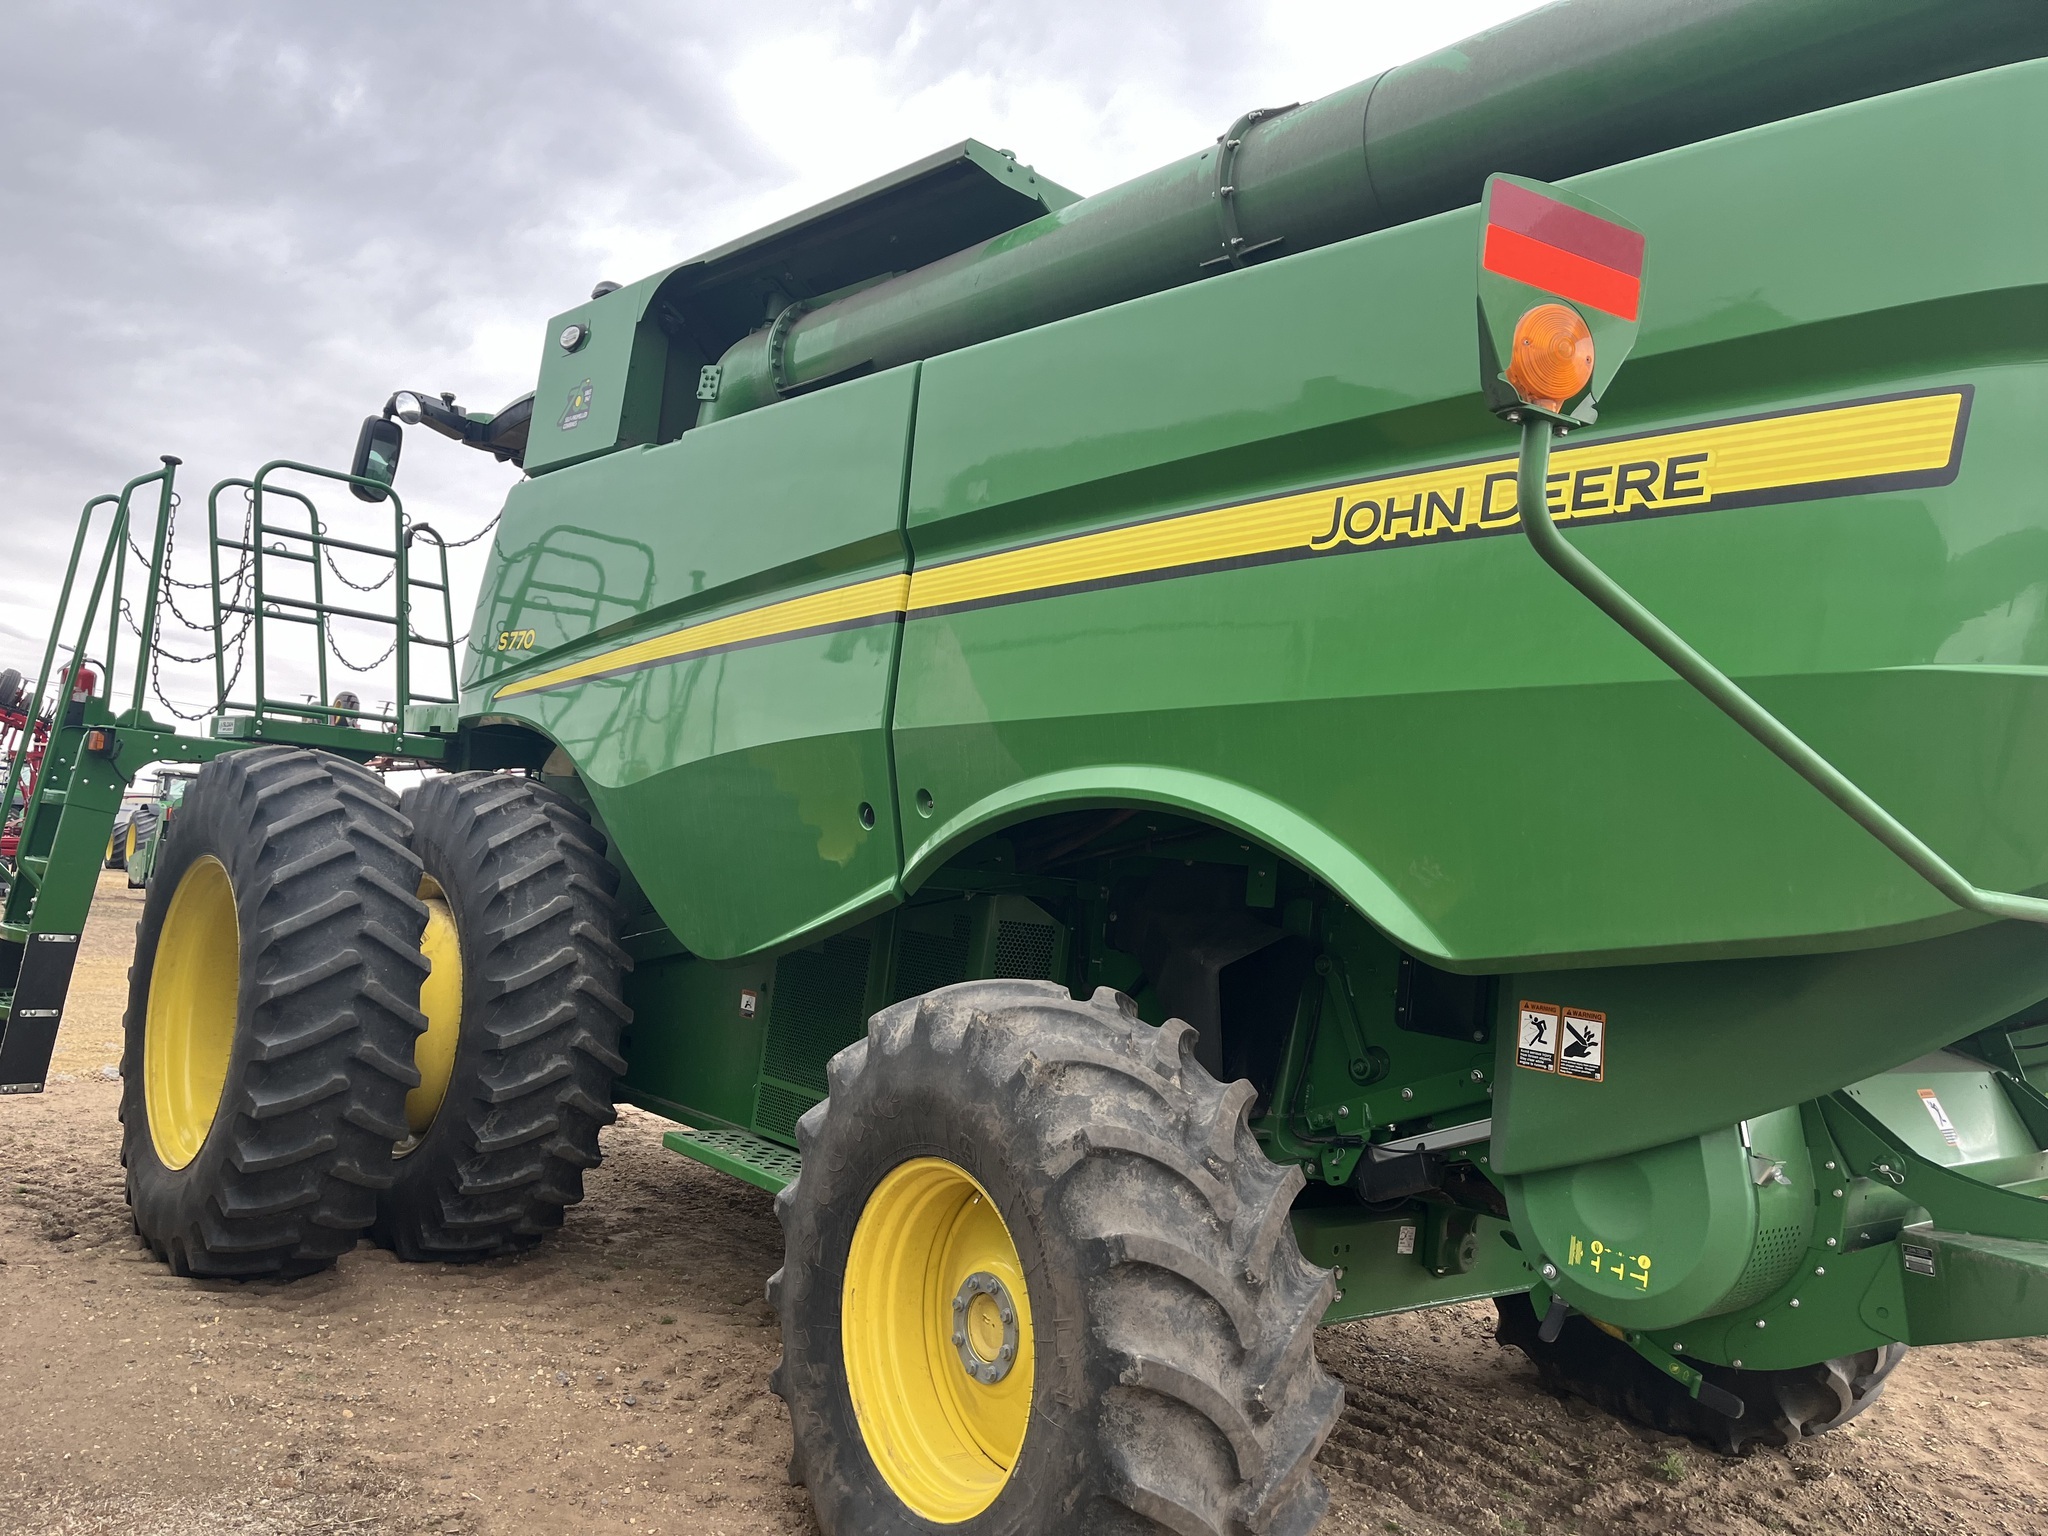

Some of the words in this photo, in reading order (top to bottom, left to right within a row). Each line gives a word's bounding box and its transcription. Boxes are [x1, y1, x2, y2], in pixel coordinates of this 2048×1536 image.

[1311, 486, 1466, 544] JOHN
[1480, 452, 1709, 523] DEERE
[497, 629, 536, 652] S770
[1531, 1003, 1557, 1013] WARNING
[1572, 1010, 1602, 1020] WARNING
